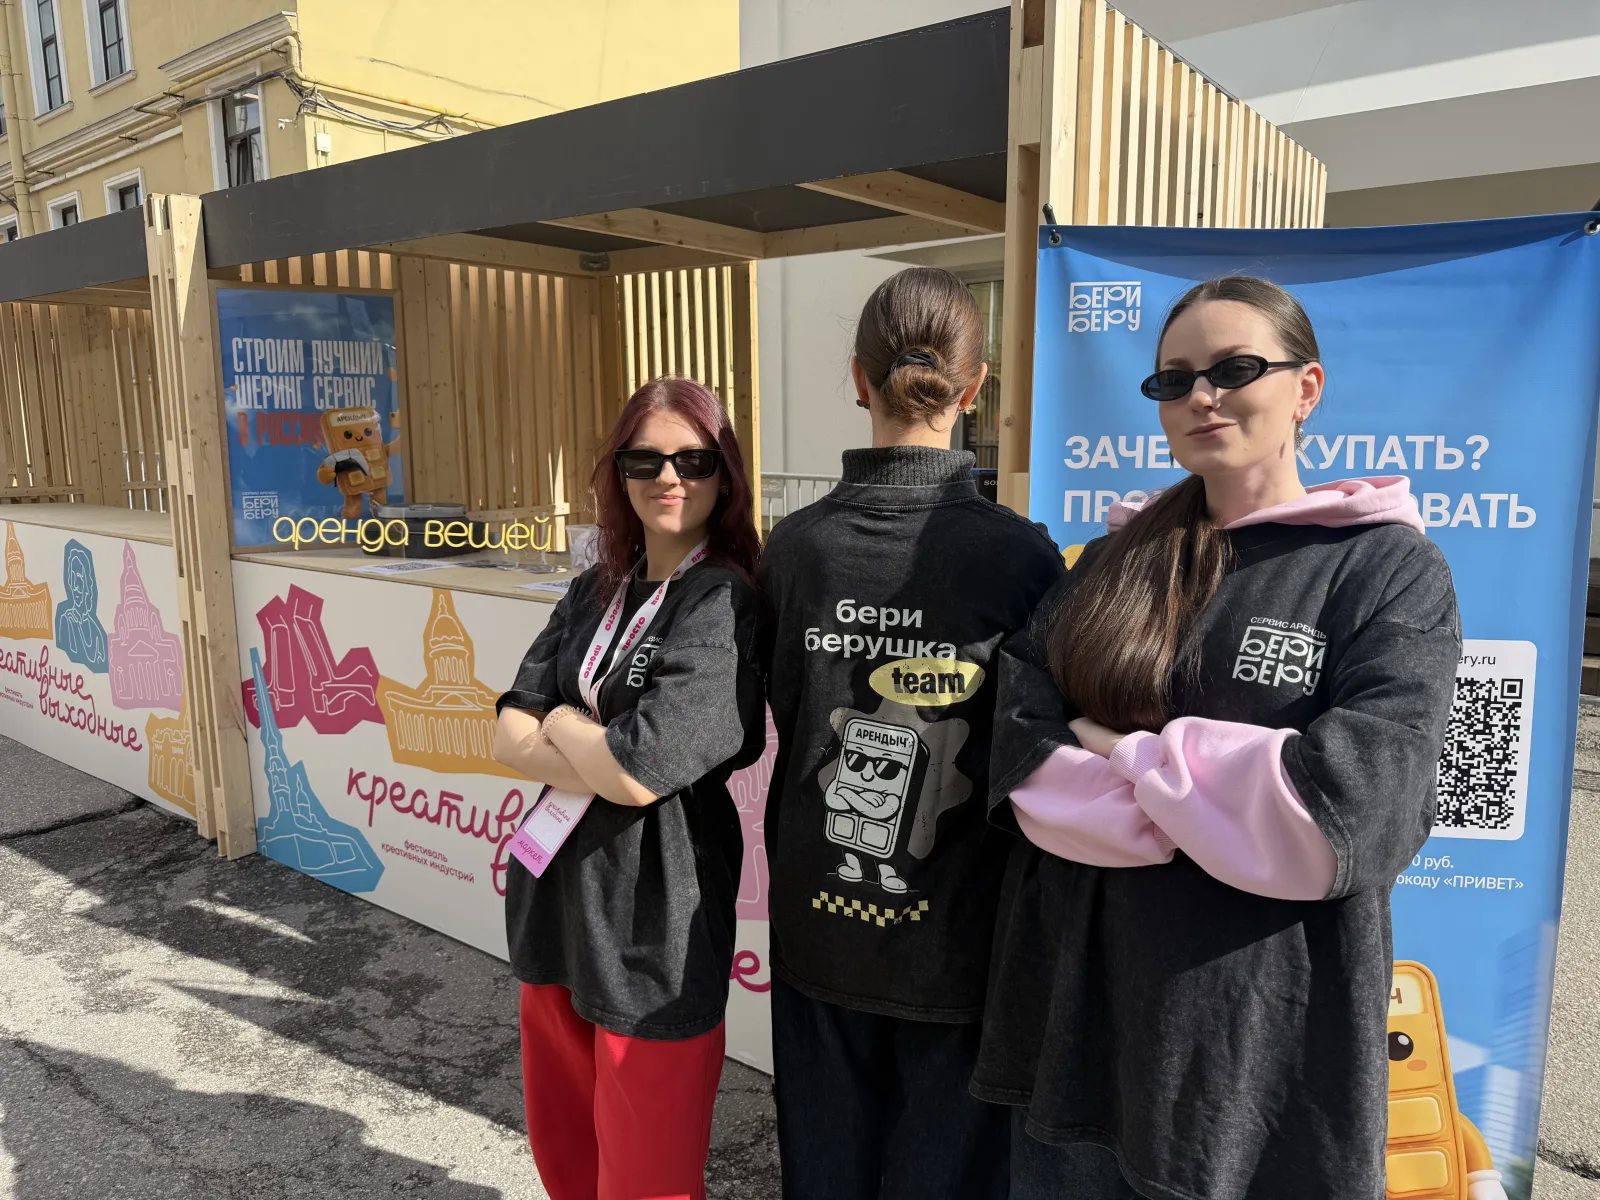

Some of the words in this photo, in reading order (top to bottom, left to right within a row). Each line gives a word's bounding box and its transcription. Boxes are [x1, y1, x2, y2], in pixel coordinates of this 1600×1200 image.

[1069, 281, 1142, 309] БЕРИ
[1067, 309, 1141, 333] БЕРУ
[232, 337, 305, 373] СТРОИМ
[311, 338, 384, 375] ЛУЧШИЙ
[234, 375, 305, 410] ШЕРИНГ
[313, 376, 377, 410] СЕРВИС
[237, 411, 249, 447] В
[1064, 435, 1183, 469] ЗАЧЕ
[1411, 492, 1537, 529] ВАТЬ
[272, 516, 409, 553] аренда
[423, 516, 552, 554] вещей
[836, 598, 924, 631] бери
[1250, 616, 1289, 629] СЕРВИС
[804, 627, 957, 661] берушка
[891, 667, 965, 694] team
[39, 674, 143, 752] выходные
[855, 727, 908, 749] АРЕНДЫЧ
[346, 767, 524, 844] креатив
[381, 842, 428, 866] креативных
[429, 861, 475, 884] индустрий
[403, 838, 449, 863] фестиваль
[1424, 855, 1454, 870] руб.
[1443, 875, 1524, 891] «ПРИВЕТ»
